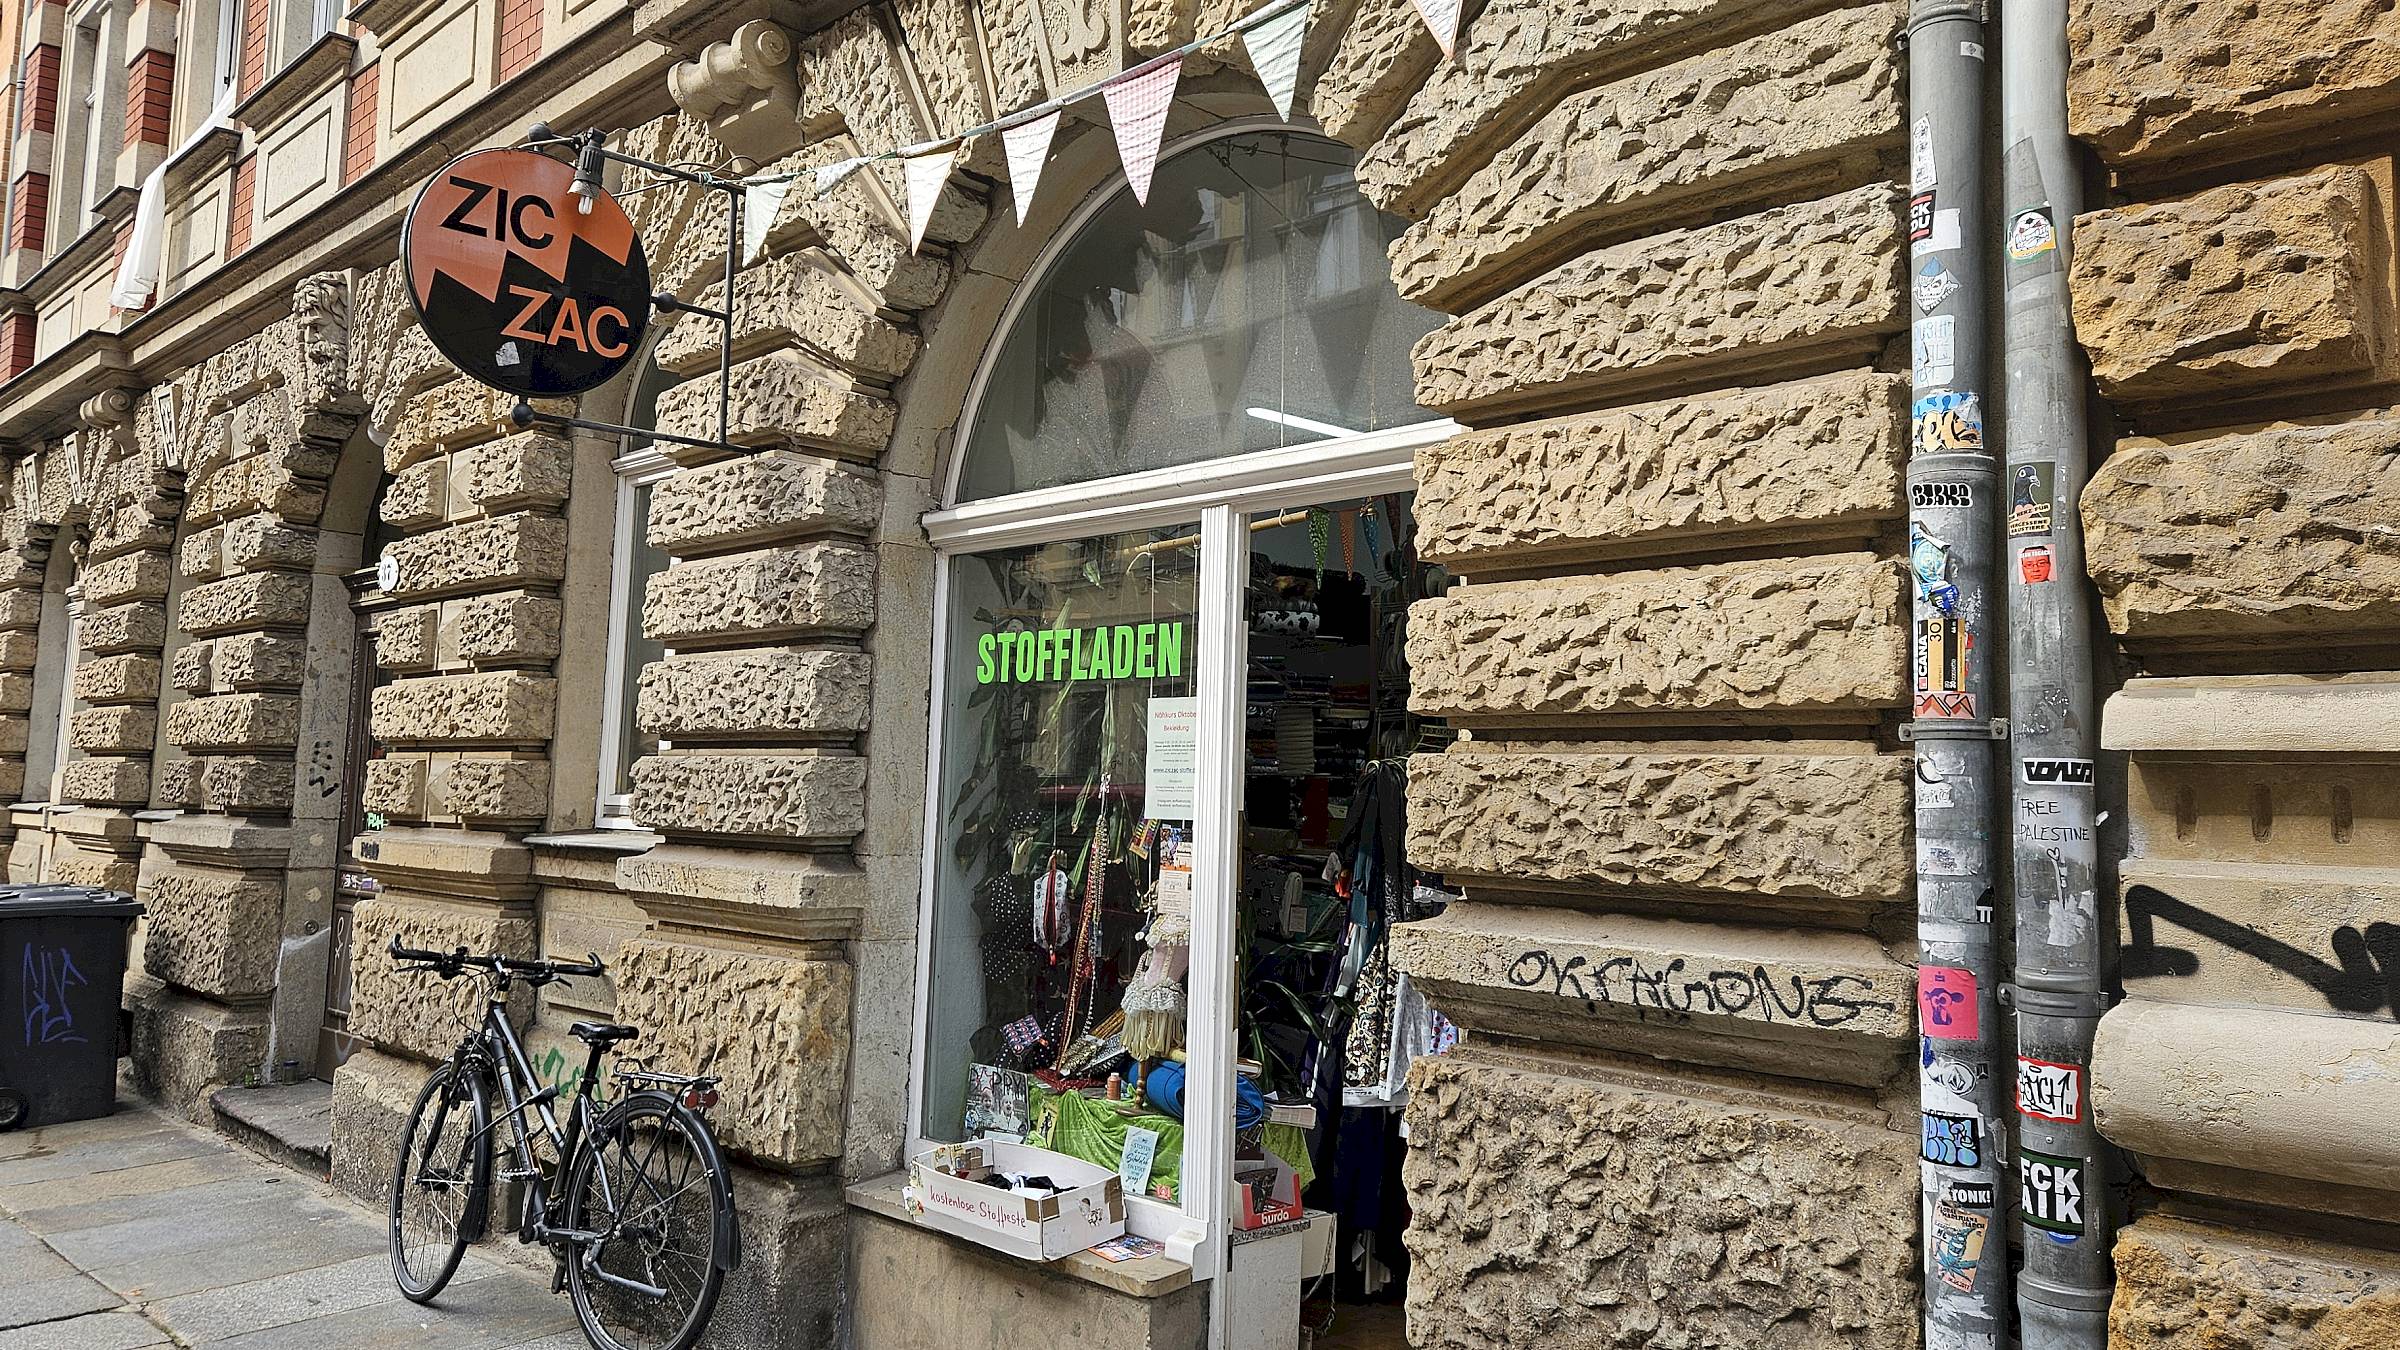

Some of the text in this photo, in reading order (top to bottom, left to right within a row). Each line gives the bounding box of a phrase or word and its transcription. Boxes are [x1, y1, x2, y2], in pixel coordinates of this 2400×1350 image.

[440, 175, 554, 249] ZIC
[1911, 202, 1930, 219] CK
[500, 284, 629, 358] ZAC
[976, 622, 1183, 684] STOFFLADEN
[1177, 710, 1197, 718] Oktobe
[2020, 799, 2060, 818] FREE
[2019, 824, 2090, 842] PALESTINE
[2020, 1156, 2081, 1196] FCK
[930, 1184, 1026, 1229] kostenlose Stoffreste
[1261, 1209, 1290, 1225] burda
[2022, 1184, 2083, 1224] AIK
